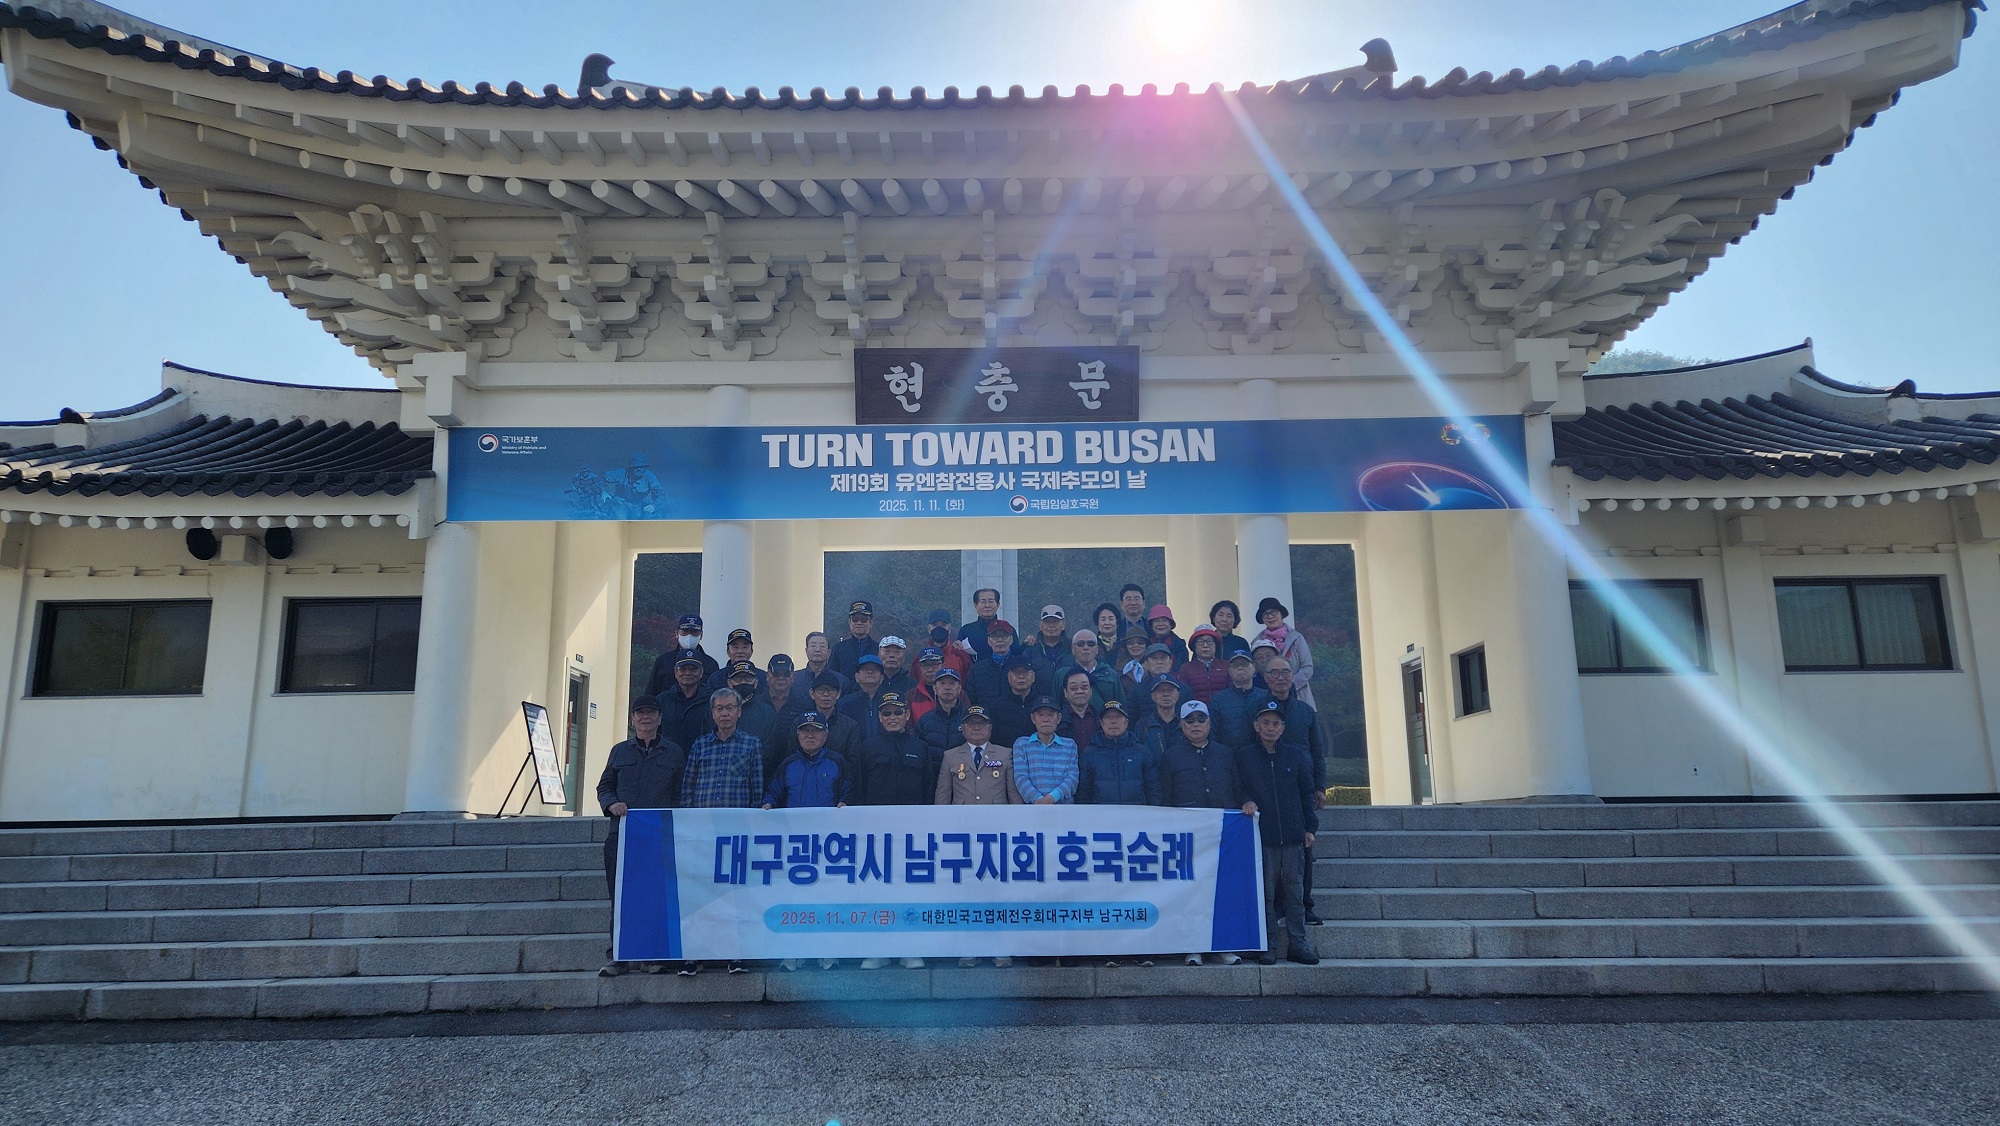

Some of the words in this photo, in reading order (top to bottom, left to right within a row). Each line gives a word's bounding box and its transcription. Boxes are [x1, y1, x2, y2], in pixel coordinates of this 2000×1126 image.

[501, 435, 539, 444] 국가보훈부
[761, 433, 873, 469] TURN
[885, 430, 1064, 467] TOWARD
[1075, 428, 1216, 464] BUSAN
[830, 473, 889, 492] 제19회
[896, 471, 1016, 492] 유엔참전용사
[1021, 470, 1121, 490] 국제추모의
[1127, 469, 1148, 490] 날
[879, 499, 909, 512] 2025.
[913, 500, 925, 511] 11.
[929, 499, 941, 511] 11.
[1030, 498, 1099, 510] 국립임실호국원
[713, 832, 894, 885] 대구광역시
[905, 831, 1045, 883] 남구지회
[1057, 831, 1196, 882] 호국순례
[781, 911, 820, 925] 2025.
[826, 911, 845, 925] 11.
[922, 908, 1095, 925] 대한민국고엽제전우회대구지부
[1100, 907, 1148, 923] 남구지회
